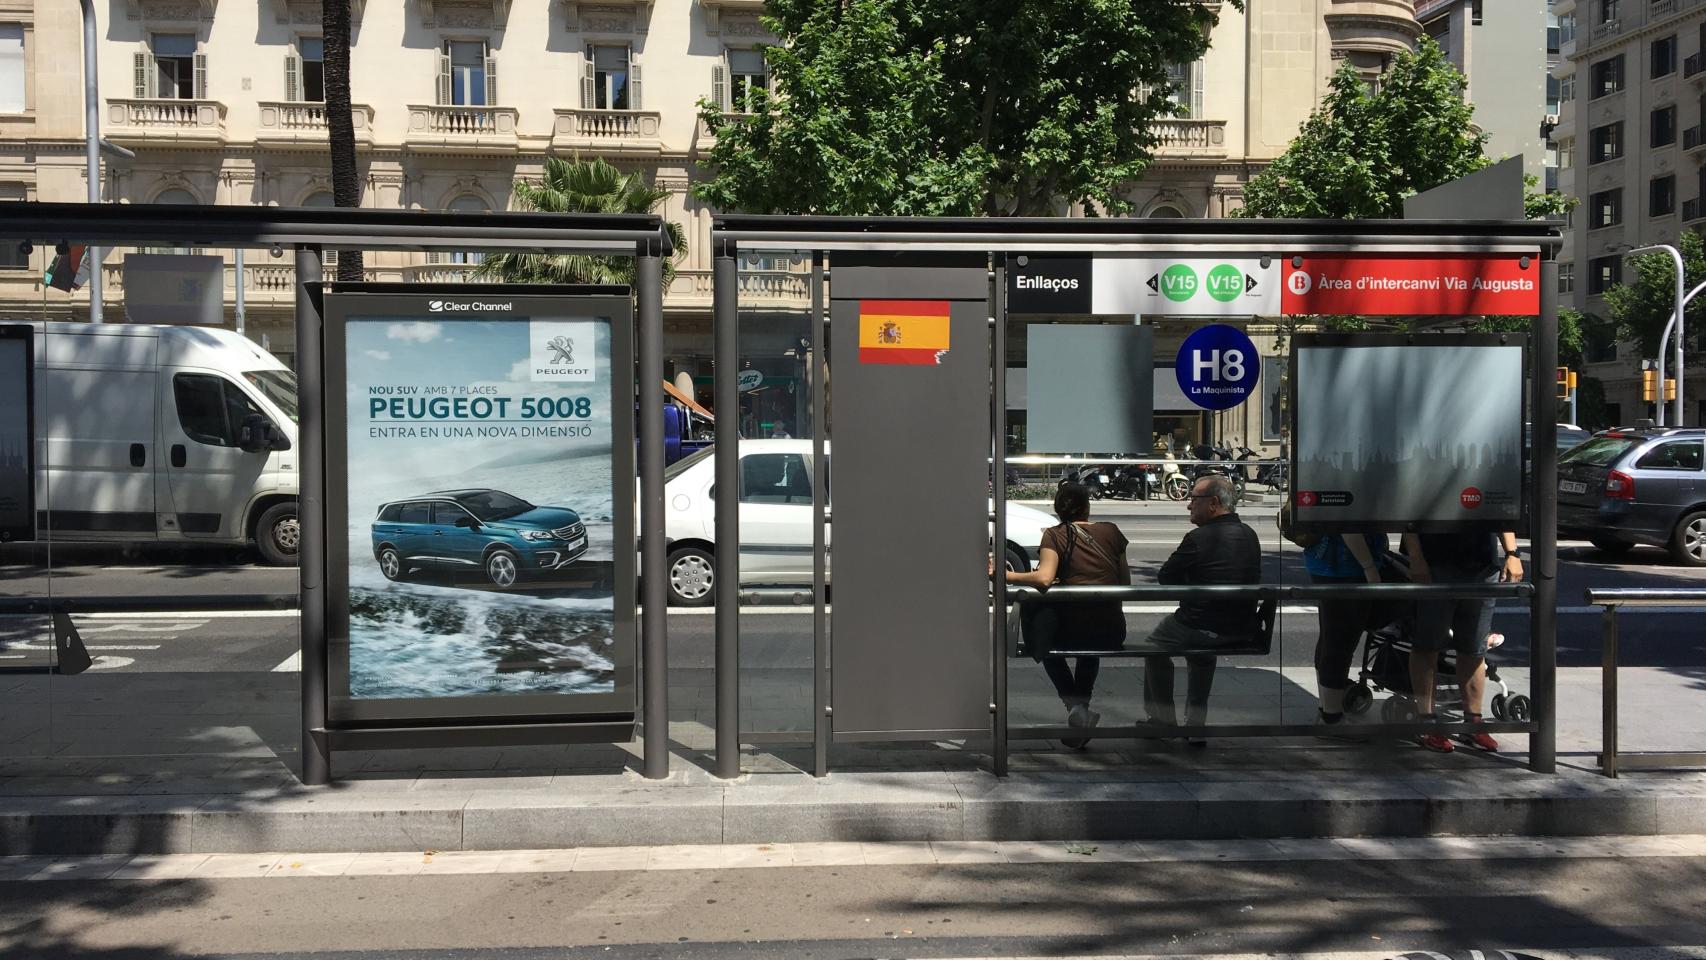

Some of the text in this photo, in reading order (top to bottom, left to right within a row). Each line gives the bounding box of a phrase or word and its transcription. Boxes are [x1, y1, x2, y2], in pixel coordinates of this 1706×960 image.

[1016, 275, 1079, 292] Enllaços
[1164, 275, 1195, 290] V15
[1209, 275, 1241, 290] V15
[1318, 273, 1353, 291] Àrea
[1444, 276, 1467, 291] Via
[1472, 276, 1534, 294] Augusta
[444, 301, 512, 311] Clear Channel
[1192, 349, 1246, 382] H8
[369, 386, 498, 395] NOU SUV AMB 7 PLACES
[1191, 386, 1245, 395] La Maquinista
[369, 397, 592, 419] PEUGEOT 5008
[369, 423, 592, 438] ENTRA EN UNA NOVA DIMENSIÓ
